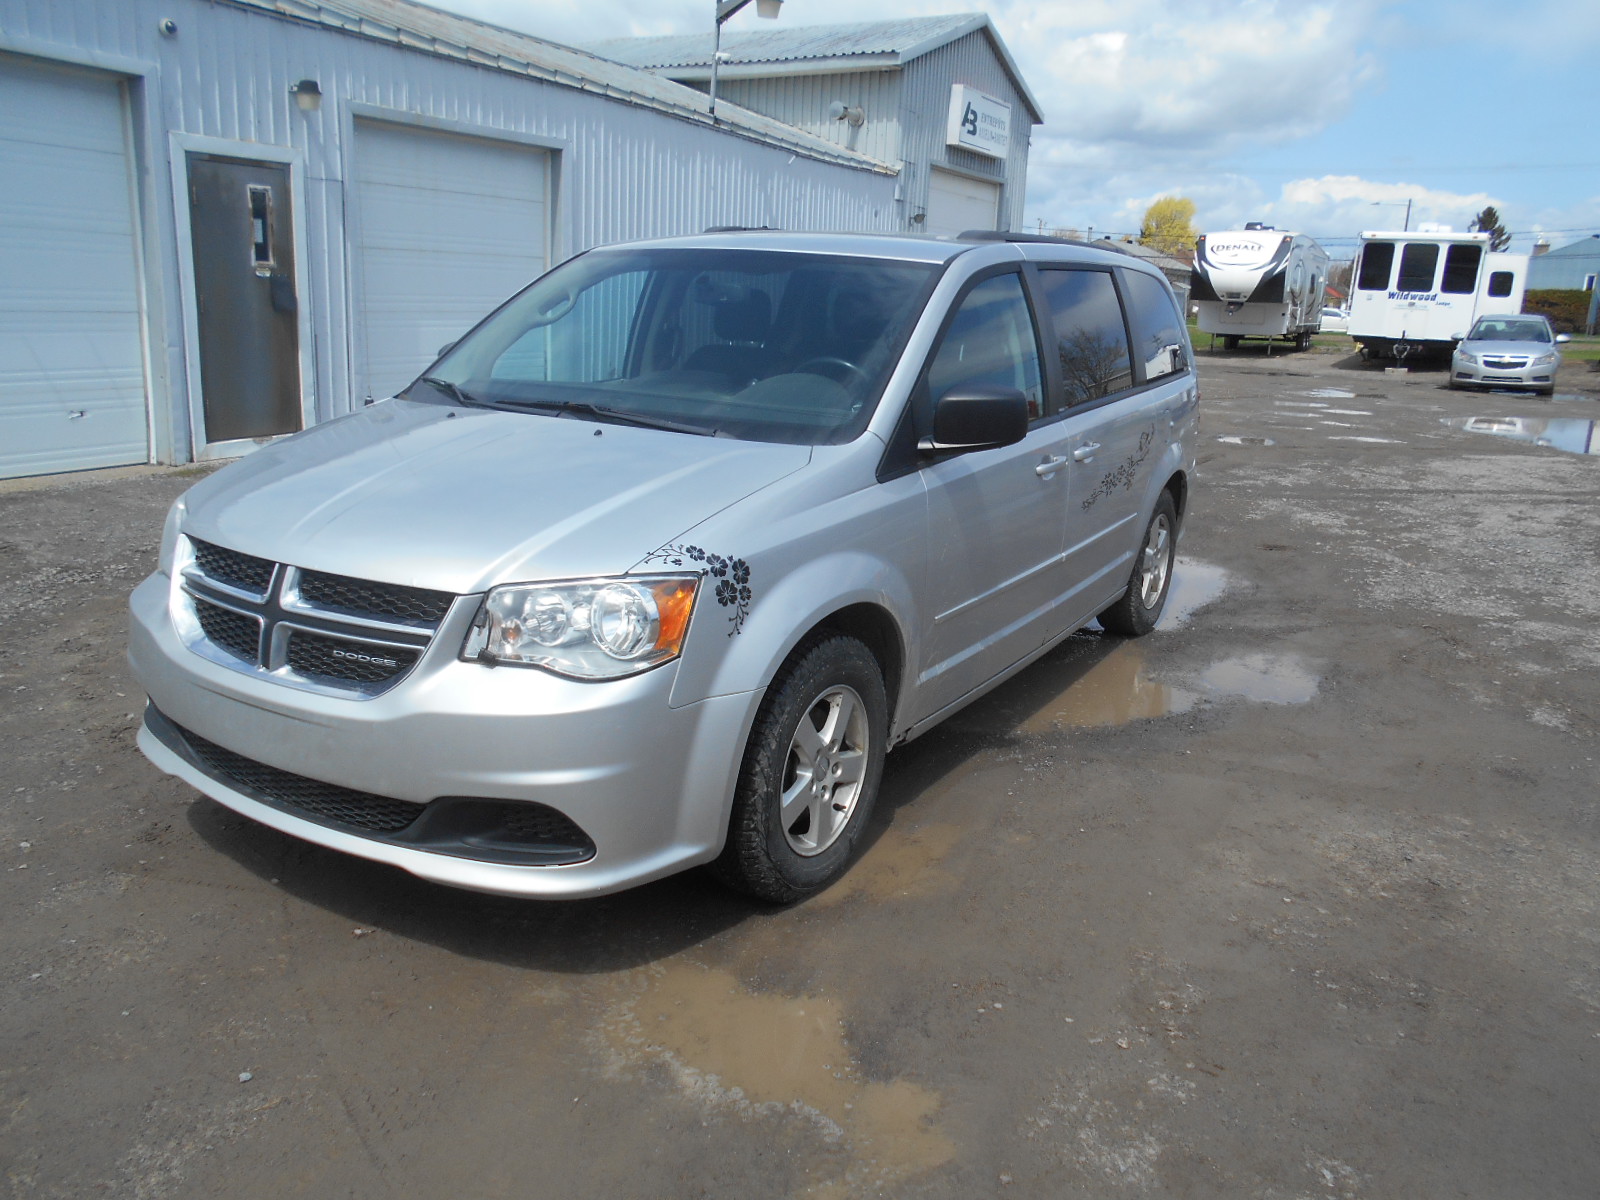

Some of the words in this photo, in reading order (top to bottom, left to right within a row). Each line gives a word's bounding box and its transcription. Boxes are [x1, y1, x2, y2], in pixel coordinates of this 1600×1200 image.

[1216, 244, 1264, 252] DENALI
[1388, 291, 1438, 301] Wildwood
[333, 650, 397, 667] DODGE
